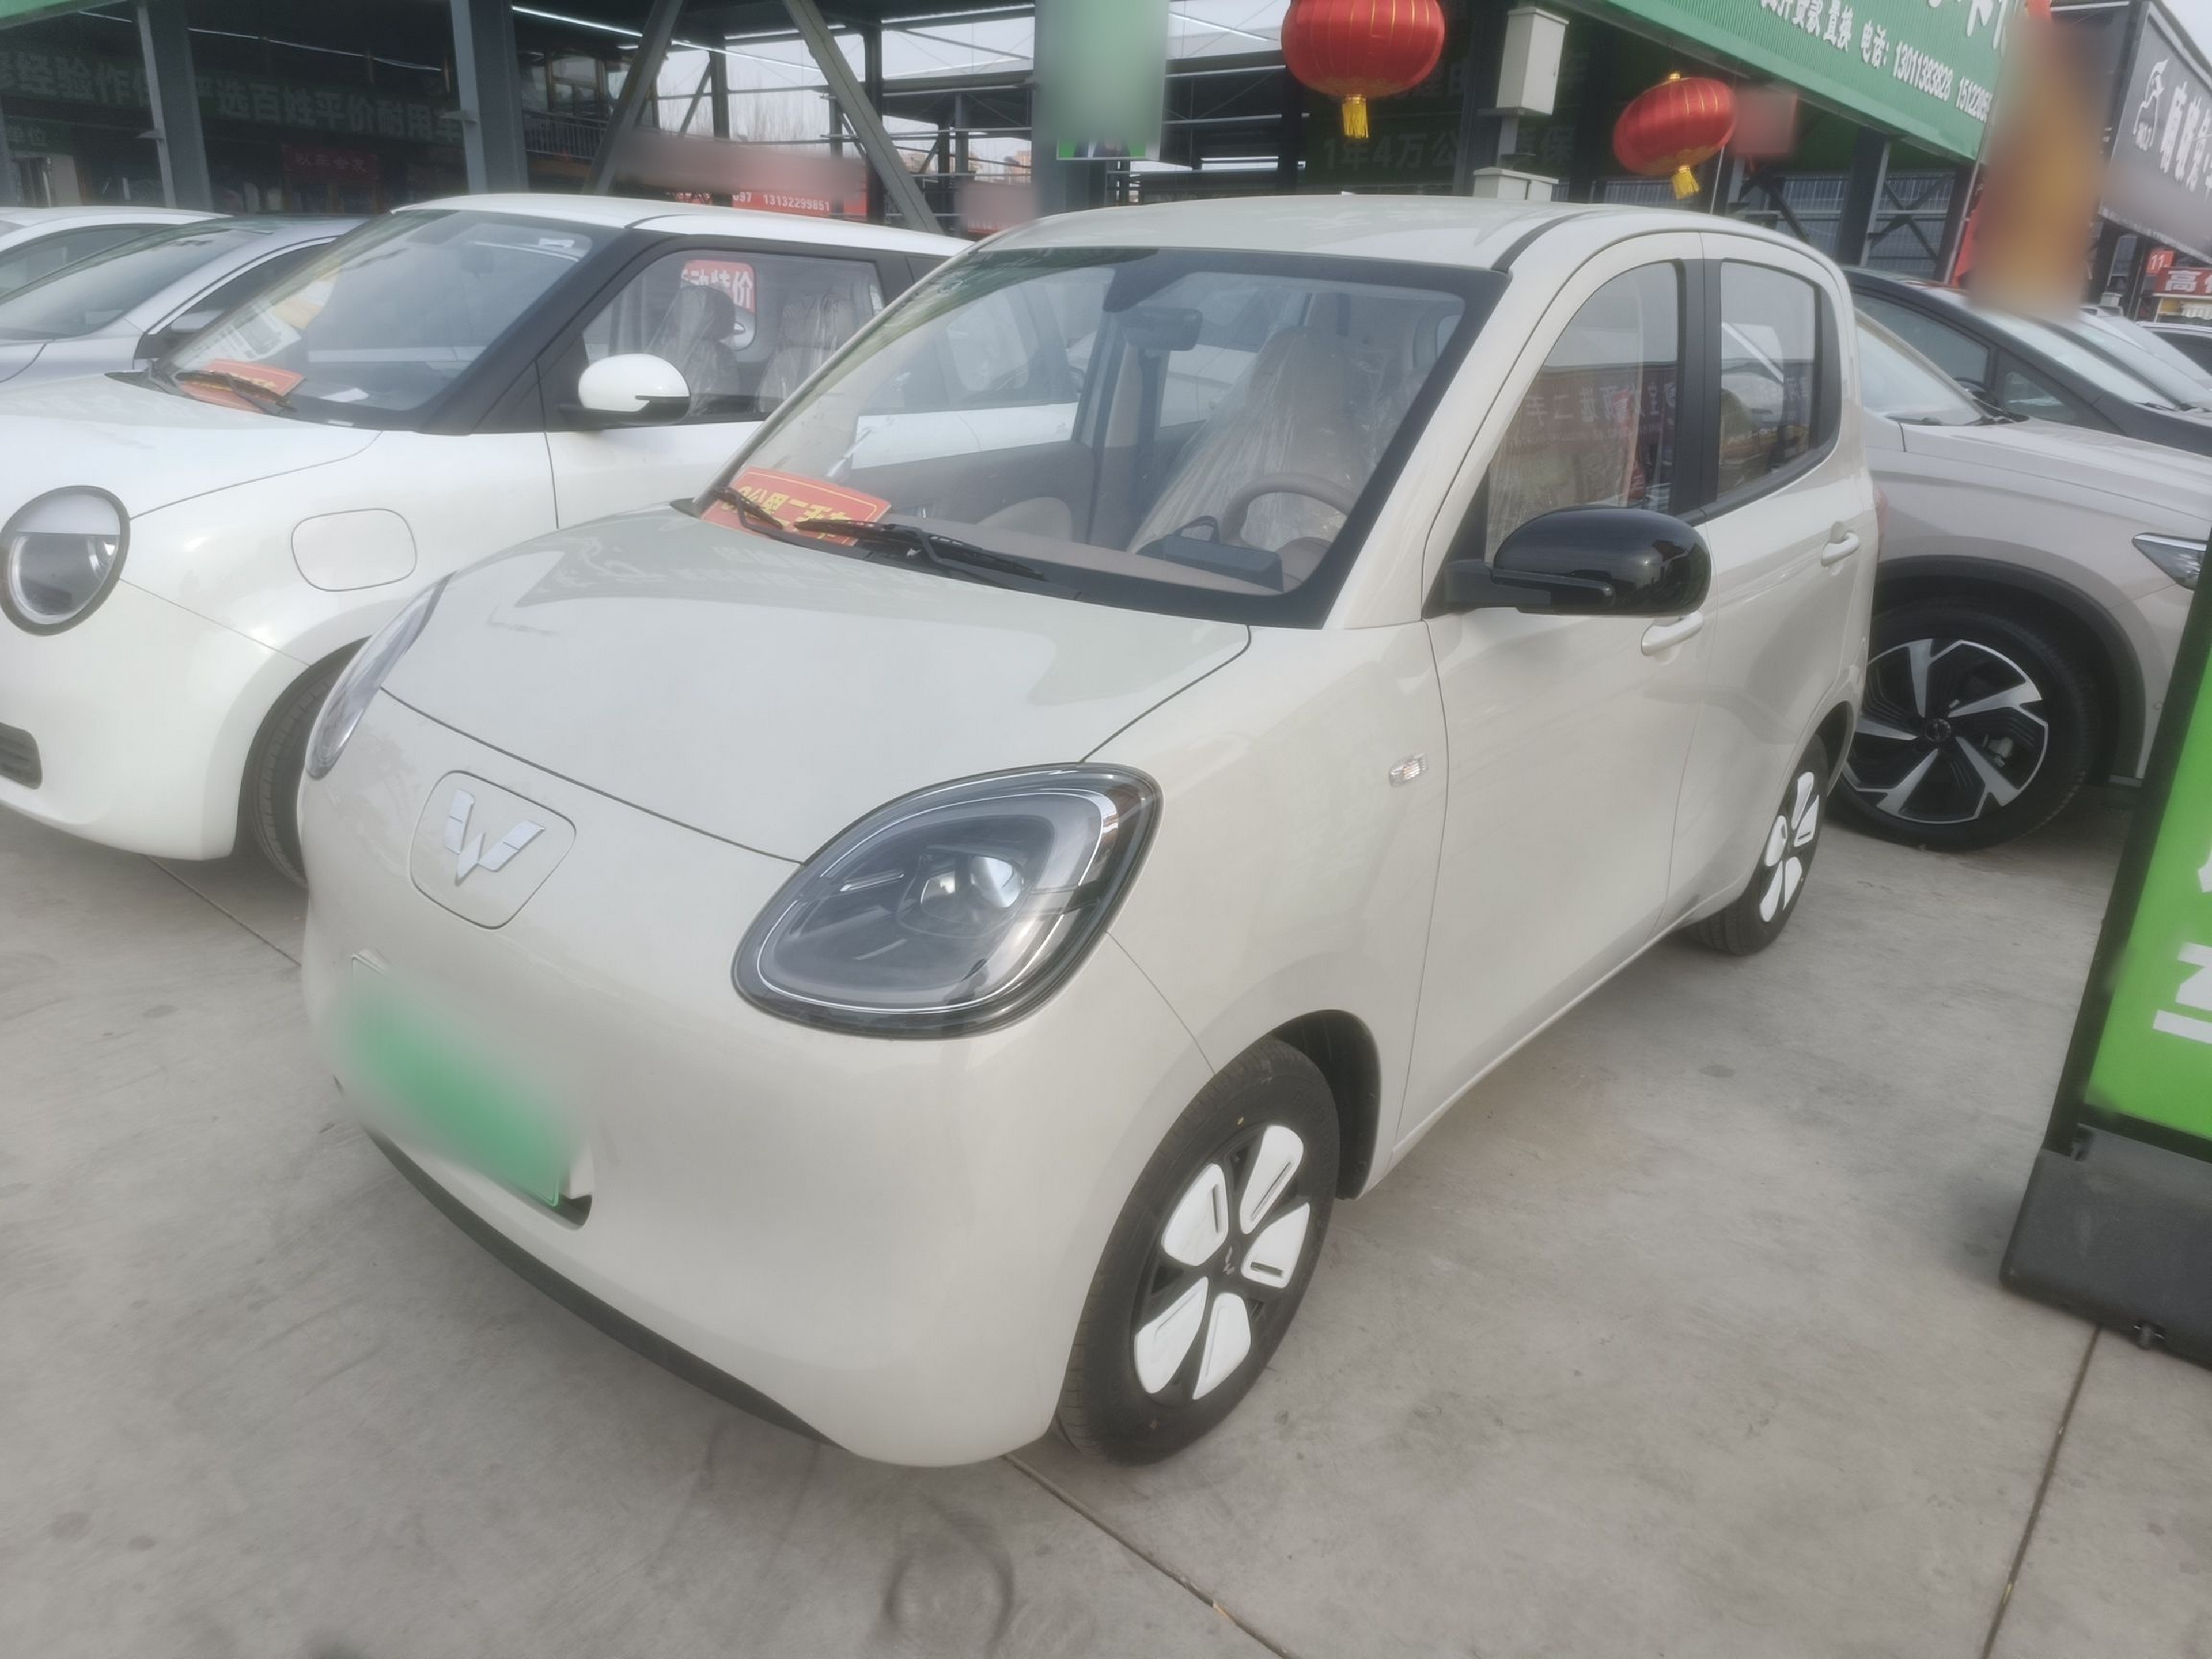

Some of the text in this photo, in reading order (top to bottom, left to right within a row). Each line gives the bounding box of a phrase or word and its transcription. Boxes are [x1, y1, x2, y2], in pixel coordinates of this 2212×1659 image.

[1760, 0, 1823, 36] 贷款
[1892, 40, 1954, 102] 13011383828
[763, 194, 830, 211] 13132299851
[2165, 270, 2212, 293] 高
